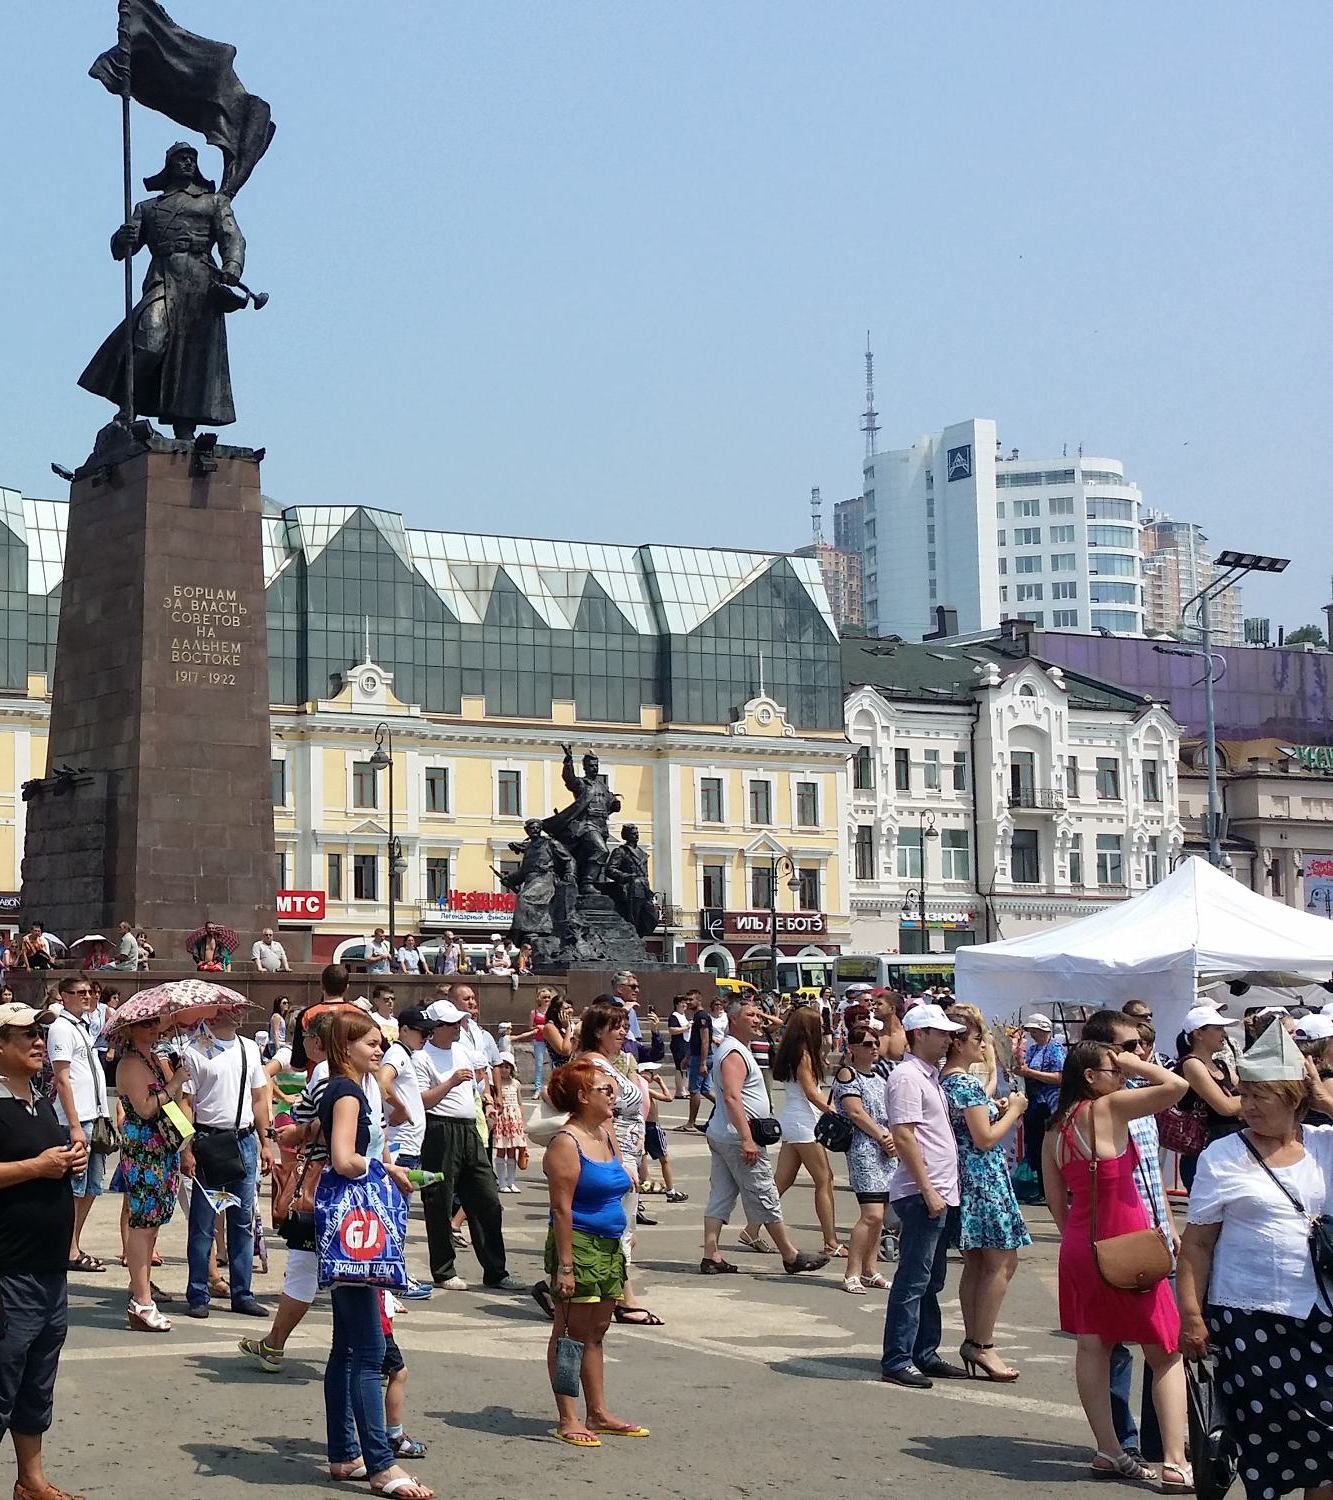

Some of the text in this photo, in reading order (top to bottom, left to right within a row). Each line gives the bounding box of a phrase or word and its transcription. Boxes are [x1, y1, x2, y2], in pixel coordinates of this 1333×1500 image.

[173, 585, 236, 601] БОРЦАМ
[163, 598, 247, 615] ЗА ВЛАСТЬ
[171, 612, 241, 627] СОВЕТОВ
[196, 626, 216, 638] НА
[171, 638, 241, 654] ДАЛЬНЕМ
[171, 651, 241, 666] ВОСТОКЕ
[276, 896, 320, 912] МТС
[449, 889, 517, 912] HESBURG
[736, 916, 764, 930] ИЛЬ
[334, 1264, 395, 1275] ЛУЧШАЯ ЦЕНА
